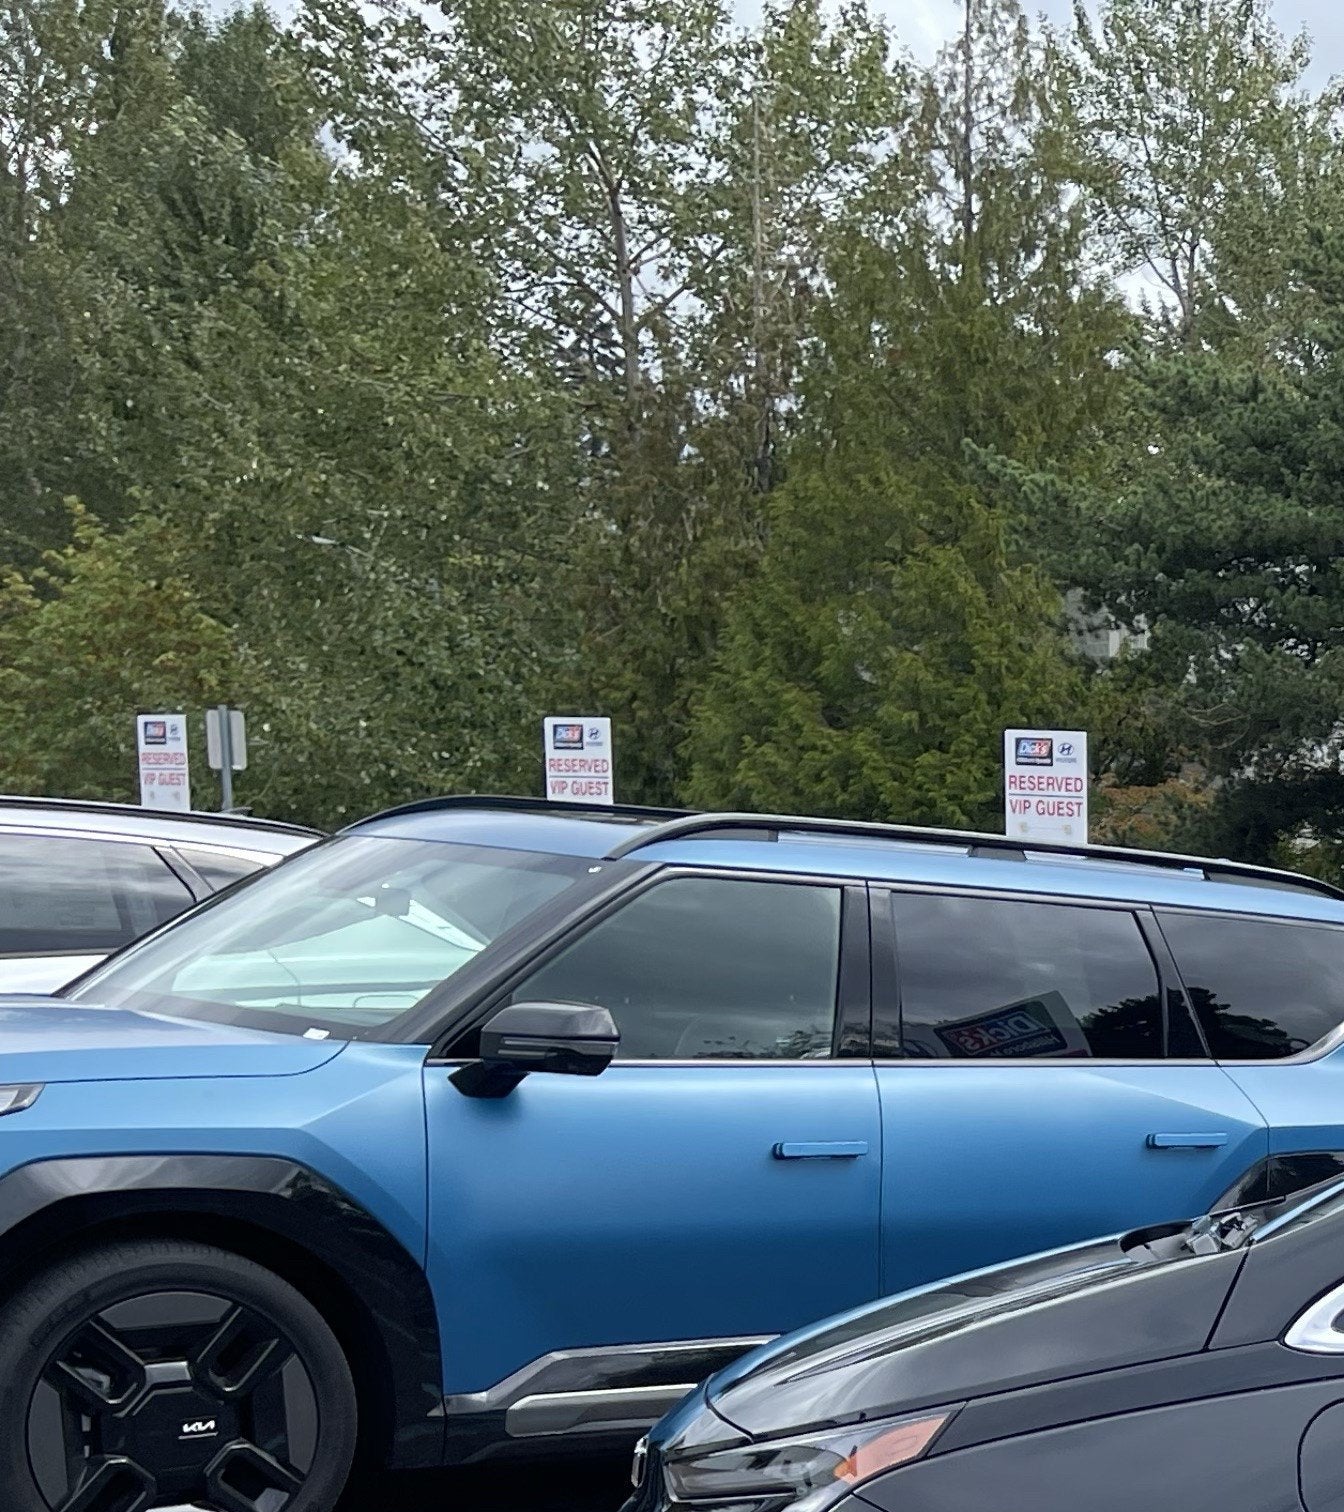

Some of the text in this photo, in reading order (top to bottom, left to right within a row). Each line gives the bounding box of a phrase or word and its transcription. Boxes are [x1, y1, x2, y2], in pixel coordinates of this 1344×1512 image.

[548, 758, 610, 774] RESERVED
[550, 780, 609, 796] VIP GUEST
[1008, 774, 1084, 793] RESERVED
[1009, 799, 1084, 818] VIP GUEST
